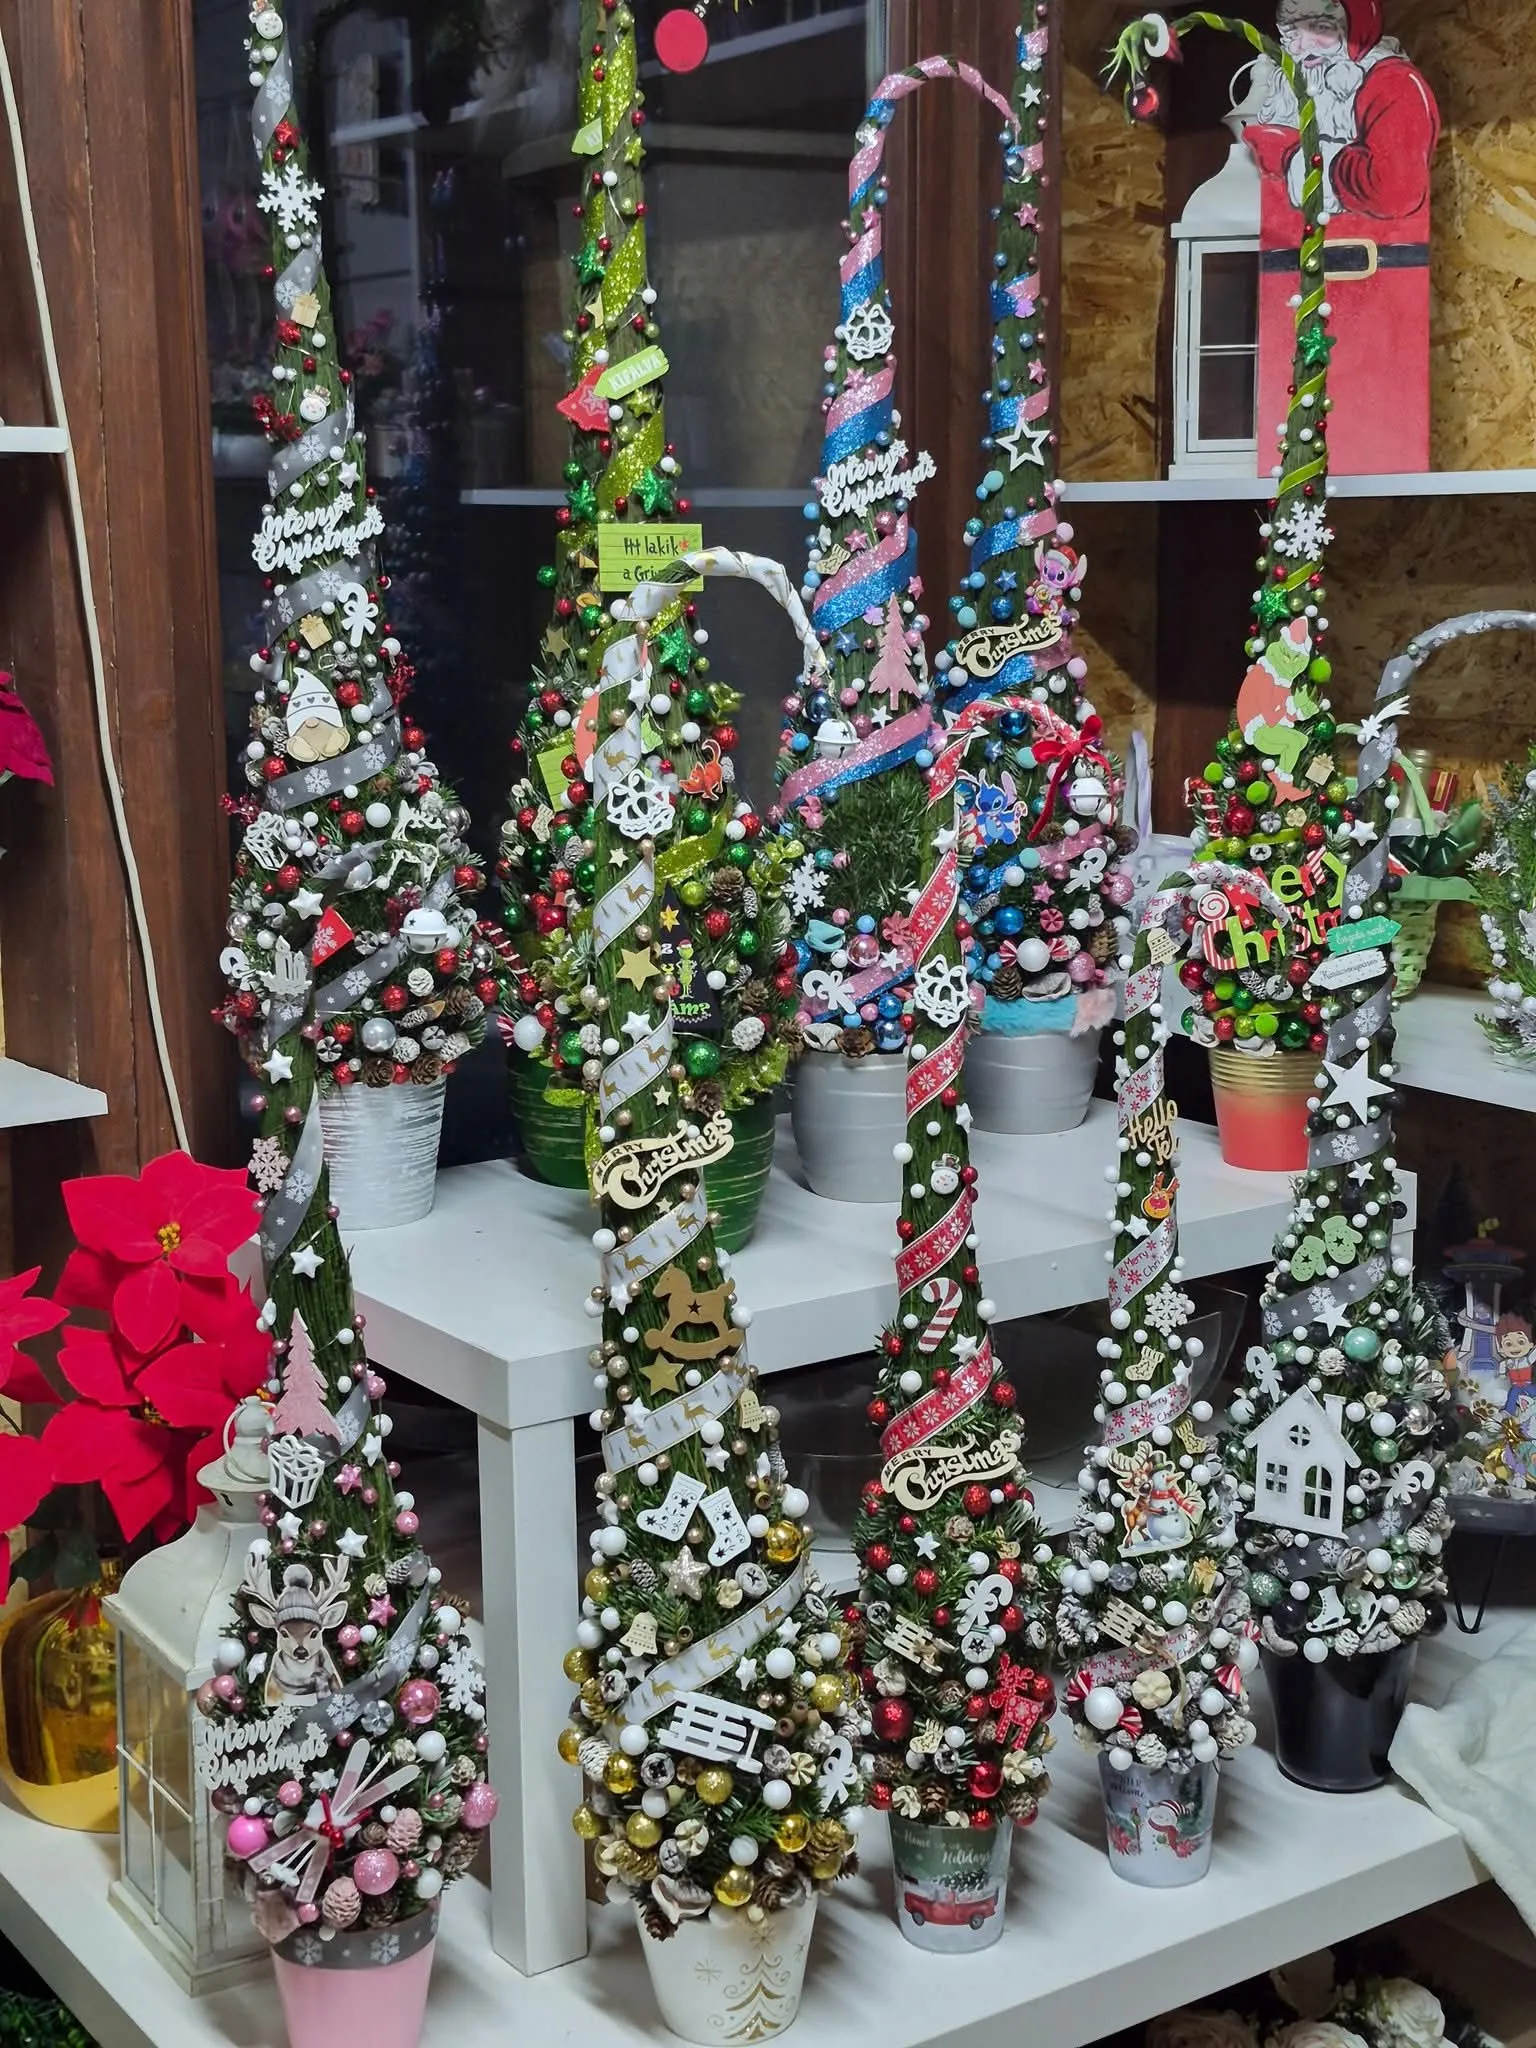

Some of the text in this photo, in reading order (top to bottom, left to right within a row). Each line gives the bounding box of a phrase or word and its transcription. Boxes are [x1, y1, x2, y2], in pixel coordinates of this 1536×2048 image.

[820, 460, 937, 518] Christmas
[827, 451, 899, 489] Merry
[262, 504, 343, 542] Merry
[252, 513, 386, 573] Christmas
[644, 535, 679, 556] lakik
[623, 568, 632, 580] a
[958, 628, 995, 652] MERRY
[966, 610, 1063, 677] Christmas
[595, 1142, 643, 1177] MERRY
[607, 1110, 733, 1210] Christmas
[1123, 1249, 1149, 1271] Merry
[884, 1449, 932, 1478] MERRY
[894, 1428, 1021, 1511] Christmas
[206, 1719, 284, 1757] Merry
[200, 1738, 329, 1790] Christmas
